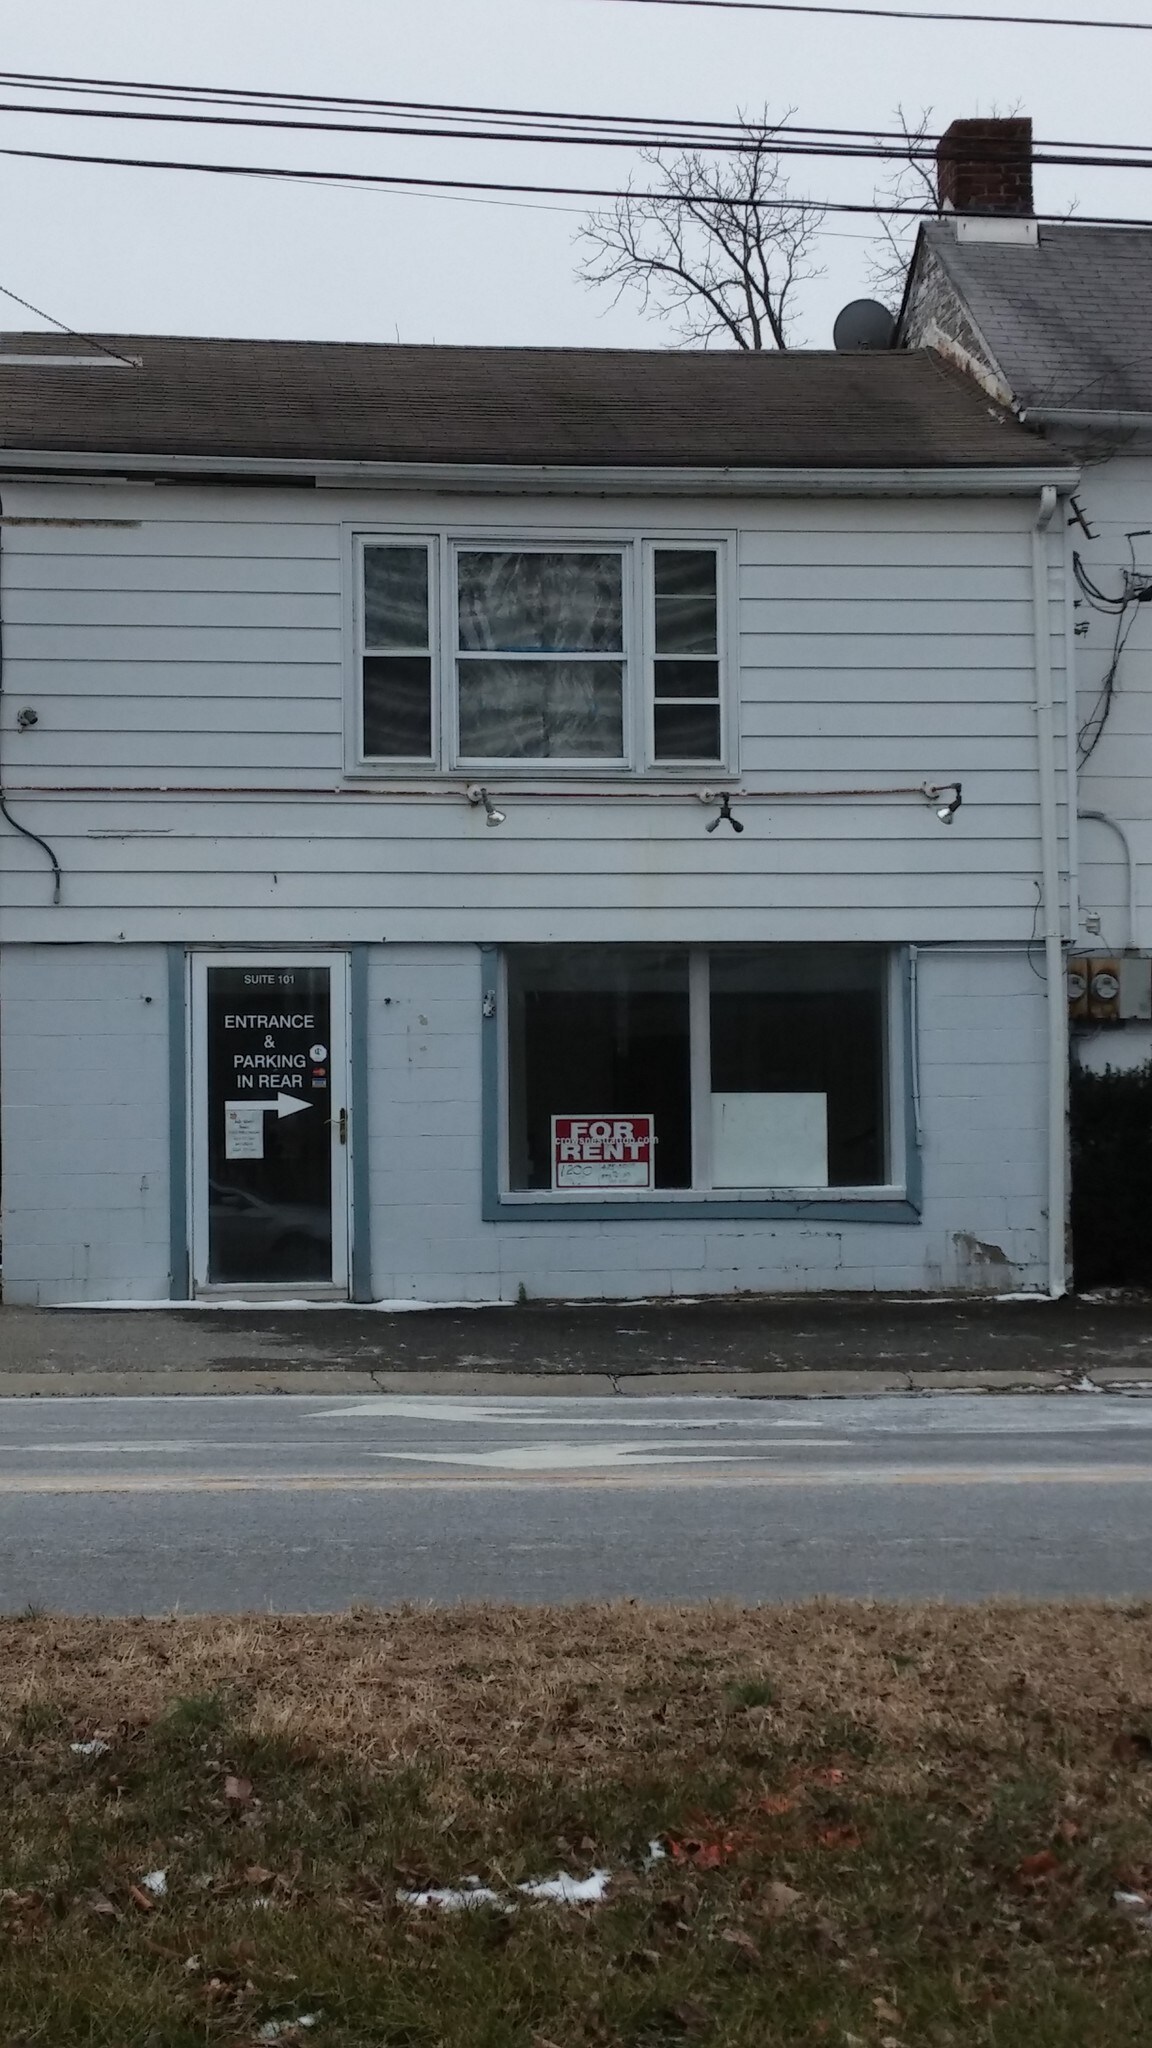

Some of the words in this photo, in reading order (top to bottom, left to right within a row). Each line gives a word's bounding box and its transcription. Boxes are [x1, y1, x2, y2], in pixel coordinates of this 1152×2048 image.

[244, 974, 275, 985] SUITE
[278, 974, 295, 985] 101
[224, 1015, 314, 1029] ENTRANCE
[263, 1034, 275, 1049] &
[233, 1054, 306, 1069] PARKING
[237, 1074, 253, 1088] IN
[259, 1074, 303, 1088] REAR
[570, 1121, 634, 1139] FOR
[560, 1142, 644, 1160] RENT
